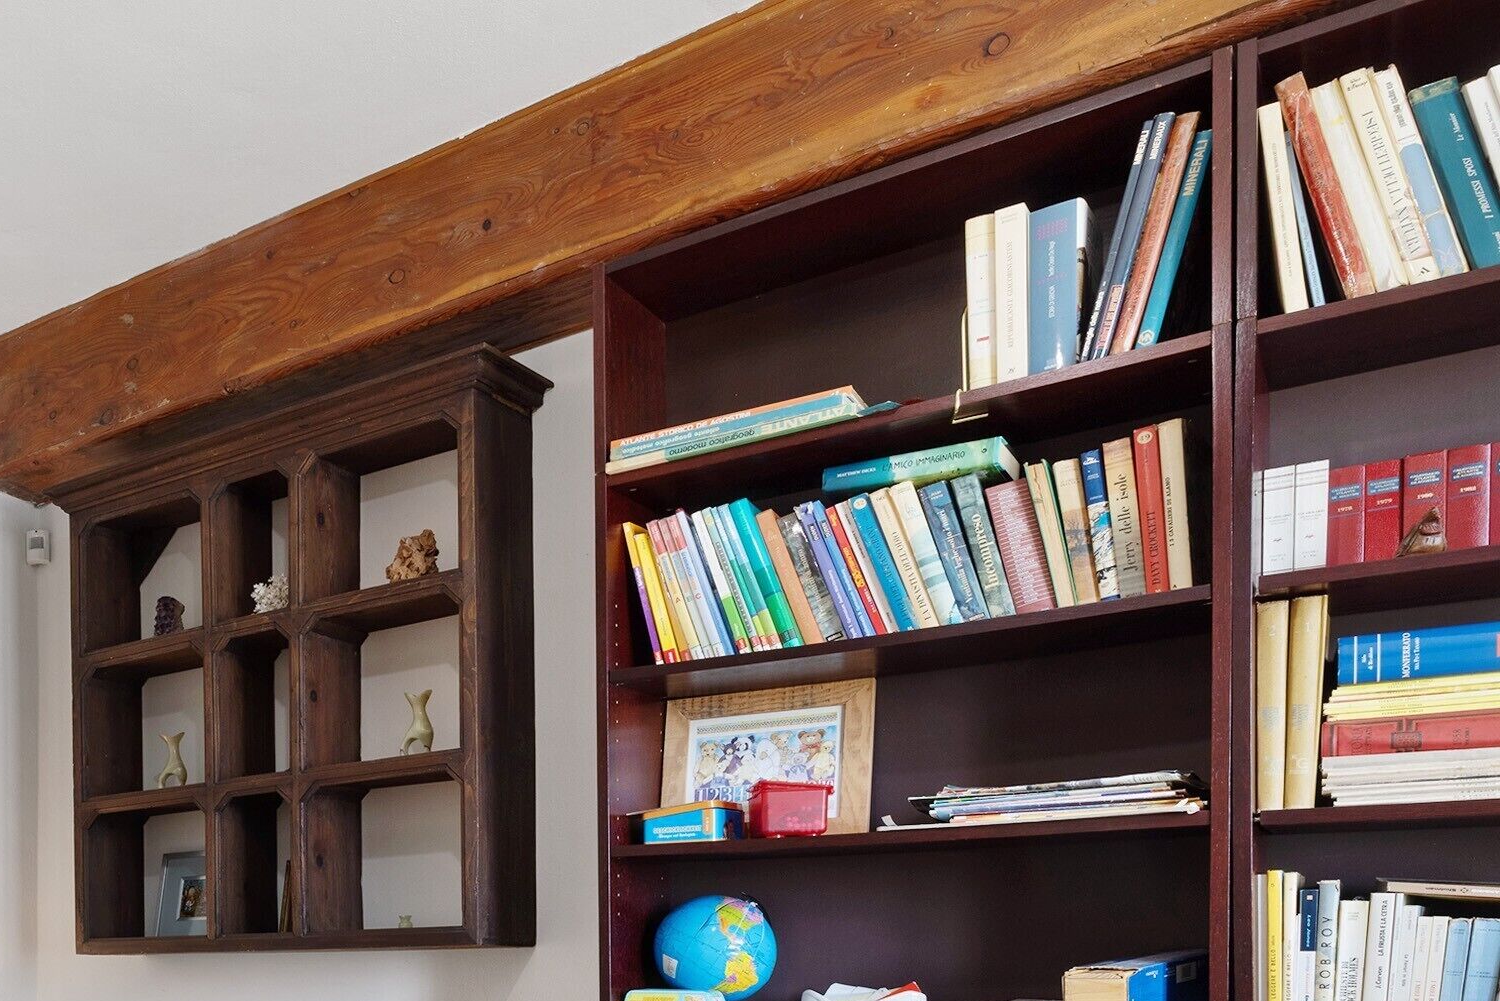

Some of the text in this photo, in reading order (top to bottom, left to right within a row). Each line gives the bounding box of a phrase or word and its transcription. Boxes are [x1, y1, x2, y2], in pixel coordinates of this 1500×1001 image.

[1133, 129, 1149, 166] MINERALI
[1150, 120, 1167, 160] MINERAUX
[1183, 139, 1209, 196] MINERALI
[1462, 157, 1478, 177] SPOSI
[1364, 116, 1391, 166] SEGRETI
[1395, 203, 1422, 254] NATURA
[1470, 179, 1493, 214] PROMESSI
[619, 433, 654, 446] ATLANTE
[658, 424, 694, 437] STORICO
[760, 407, 846, 434] ATLANTE
[669, 429, 755, 456] geografico moderno
[915, 450, 966, 466] IMMAGINARIO
[936, 510, 950, 527] mari
[1114, 473, 1139, 571] Jerry delle isole
[949, 550, 963, 569] leghe
[971, 514, 999, 590] Incompreso
[1147, 511, 1161, 586] DAVY CROCKETT
[956, 569, 974, 603] Ventimila
[1402, 633, 1411, 678] MONFERRATO
[709, 788, 719, 801] 2
[722, 787, 732, 801] 3
[1321, 916, 1333, 948] ROY
[1319, 958, 1331, 990] ROB
[1348, 957, 1359, 988] HOLMES
